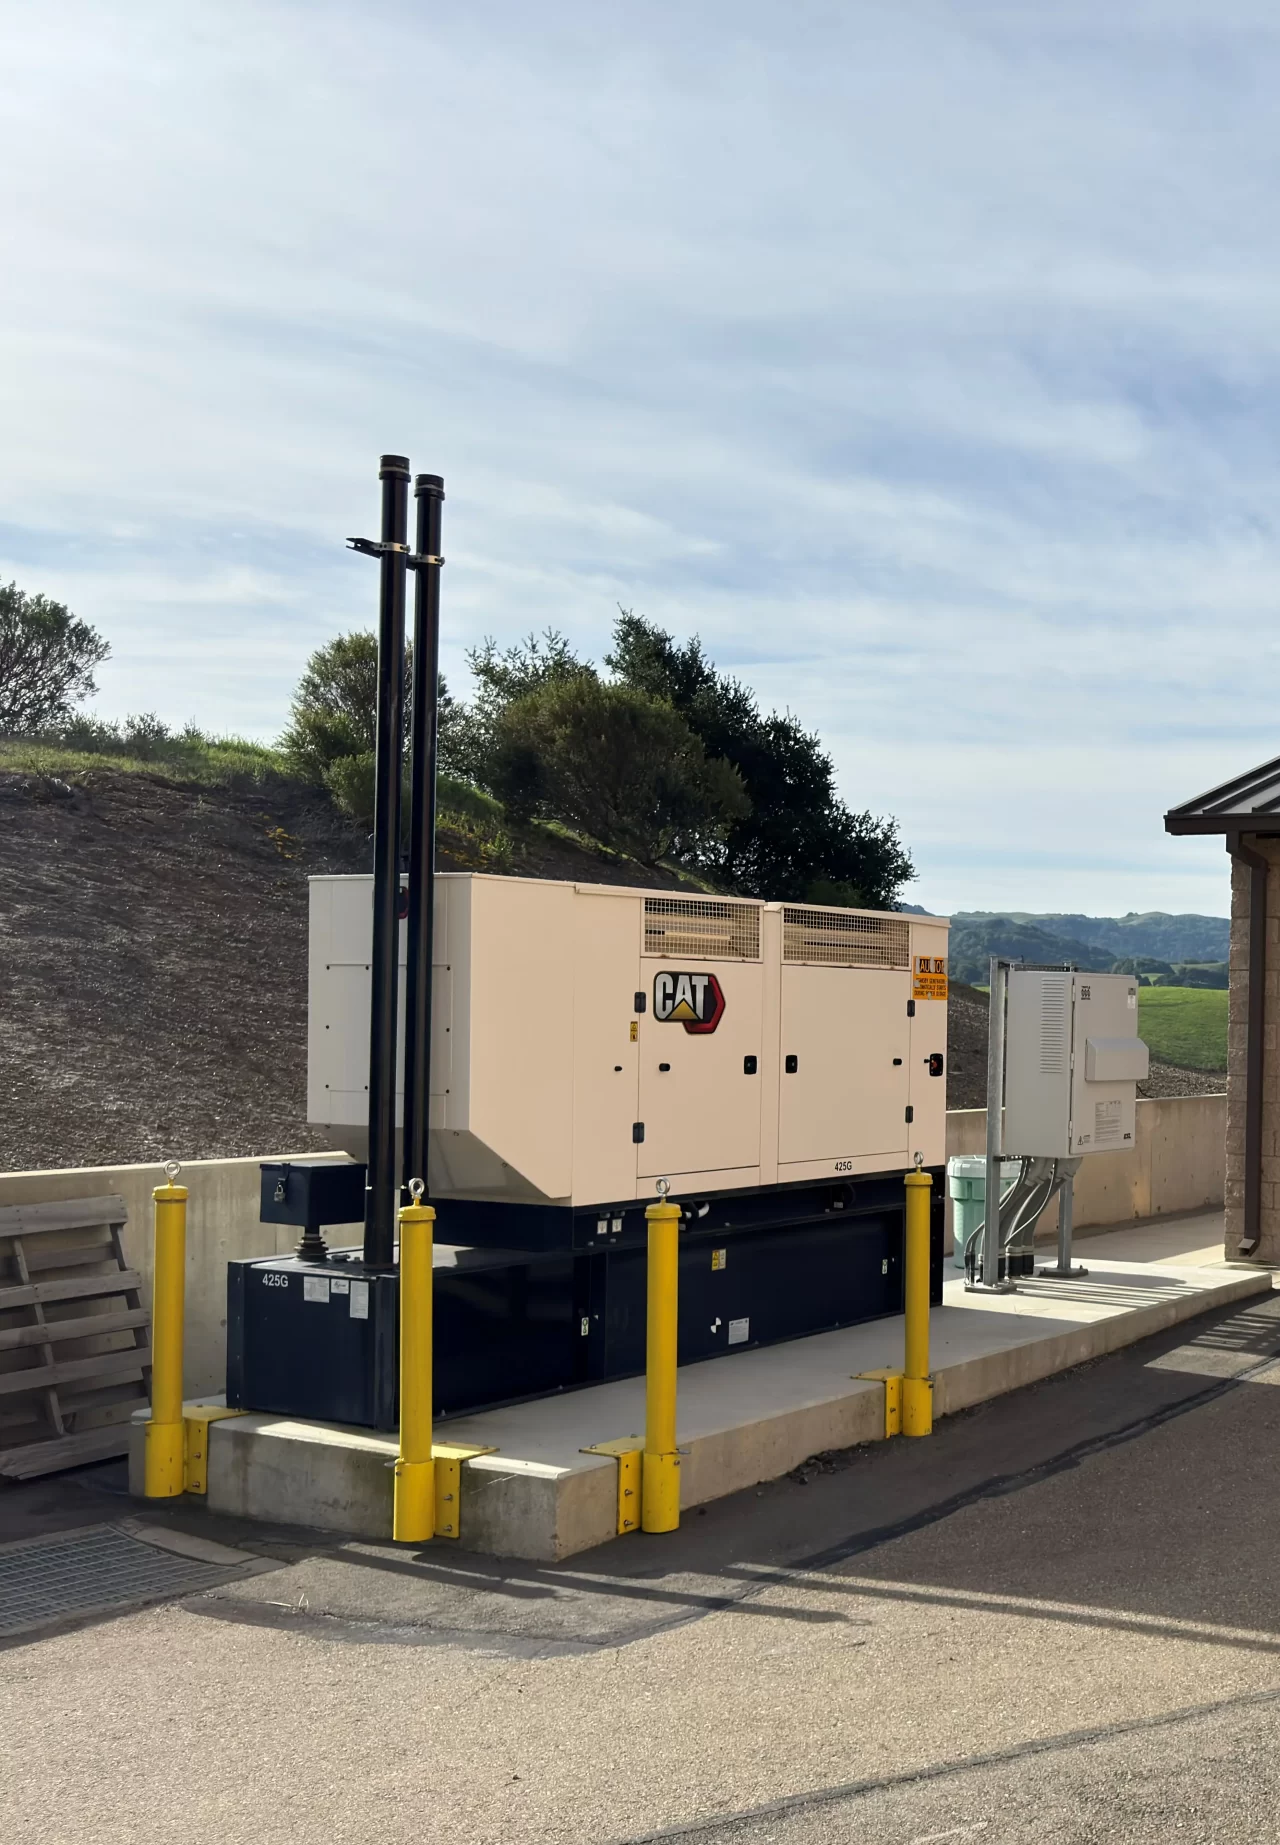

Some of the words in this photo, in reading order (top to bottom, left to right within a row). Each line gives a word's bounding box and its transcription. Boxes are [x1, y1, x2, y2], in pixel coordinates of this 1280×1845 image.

[655, 973, 708, 1020] CAT
[835, 1161, 852, 1171] 425G
[262, 1273, 289, 1287] 425G
